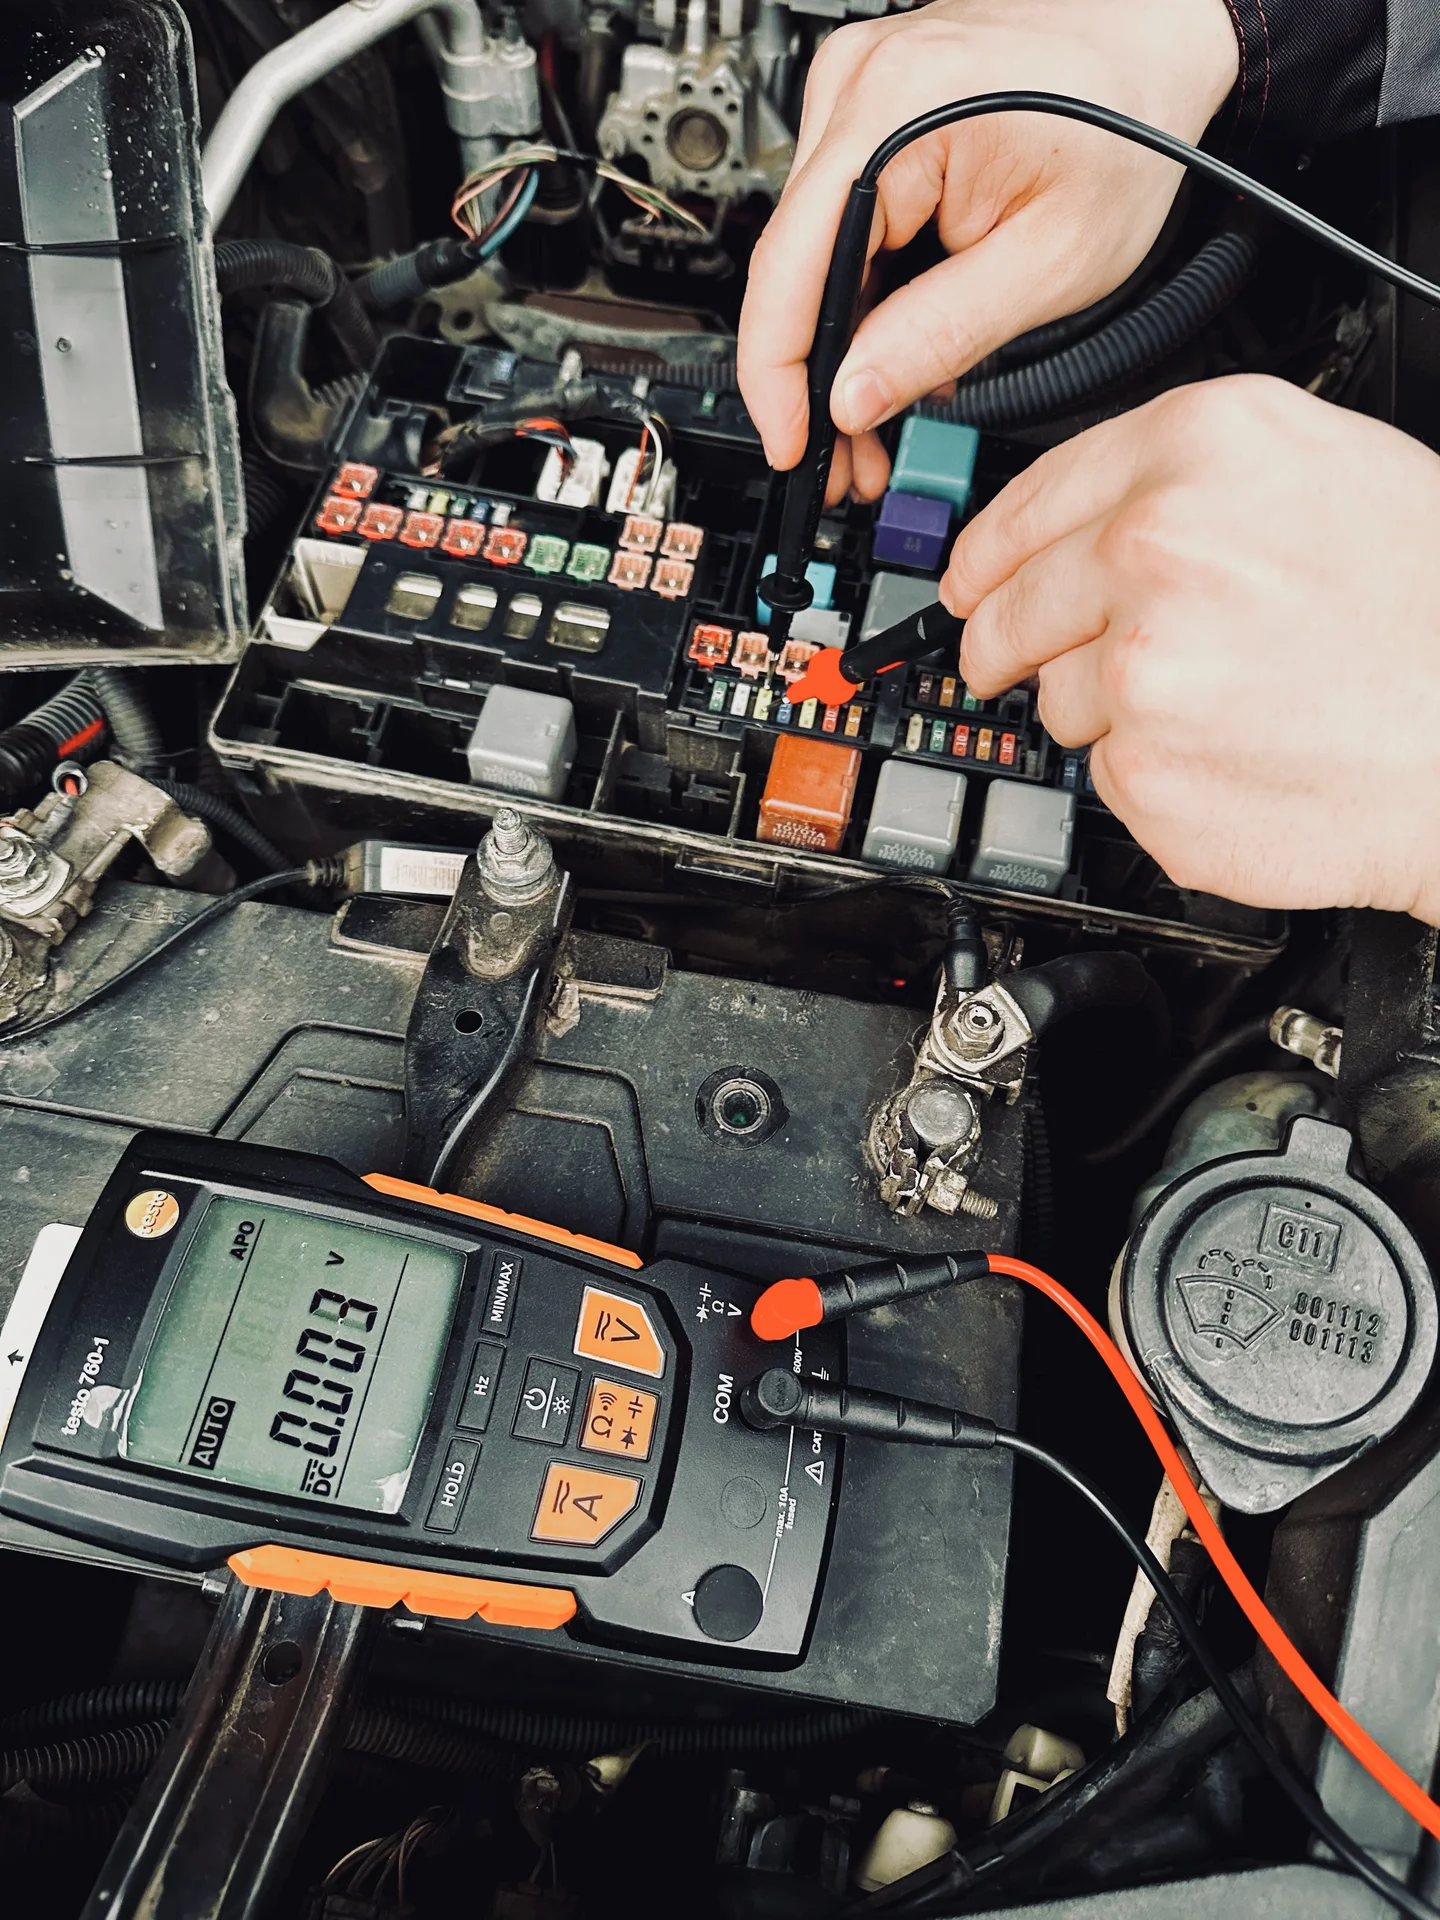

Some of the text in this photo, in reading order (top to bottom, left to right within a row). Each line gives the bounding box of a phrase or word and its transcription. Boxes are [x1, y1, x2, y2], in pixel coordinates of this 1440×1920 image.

[919, 681, 931, 694] 7.5
[933, 730, 944, 742] 30
[956, 735, 967, 747] 10
[980, 741, 990, 749] 5
[1003, 743, 1013, 754] 10
[1064, 765, 1075, 778] 15
[776, 823, 825, 839] TOYOTA
[883, 845, 934, 861] TOYOTA
[141, 1191, 169, 1235] testo
[229, 1220, 256, 1261] APO
[490, 1261, 515, 1323] MIN/MAX
[727, 1302, 743, 1317] V
[1296, 1292, 1381, 1338] 001112
[609, 1316, 641, 1343] V
[1289, 1319, 1375, 1364] 001113
[269, 1287, 378, 1458] 0.003
[792, 1348, 803, 1375] 600V
[61, 1336, 110, 1436] testo 760-1
[473, 1374, 490, 1396] Hz
[713, 1374, 735, 1424] COM
[194, 1401, 230, 1466] AUTO
[812, 1430, 823, 1454] CAT
[312, 1463, 337, 1497] DC
[440, 1462, 466, 1507] HOLD
[572, 1494, 604, 1522] A
[775, 1487, 790, 1538] max. 10A
[785, 1497, 797, 1530] fused
[681, 1590, 696, 1606] A
